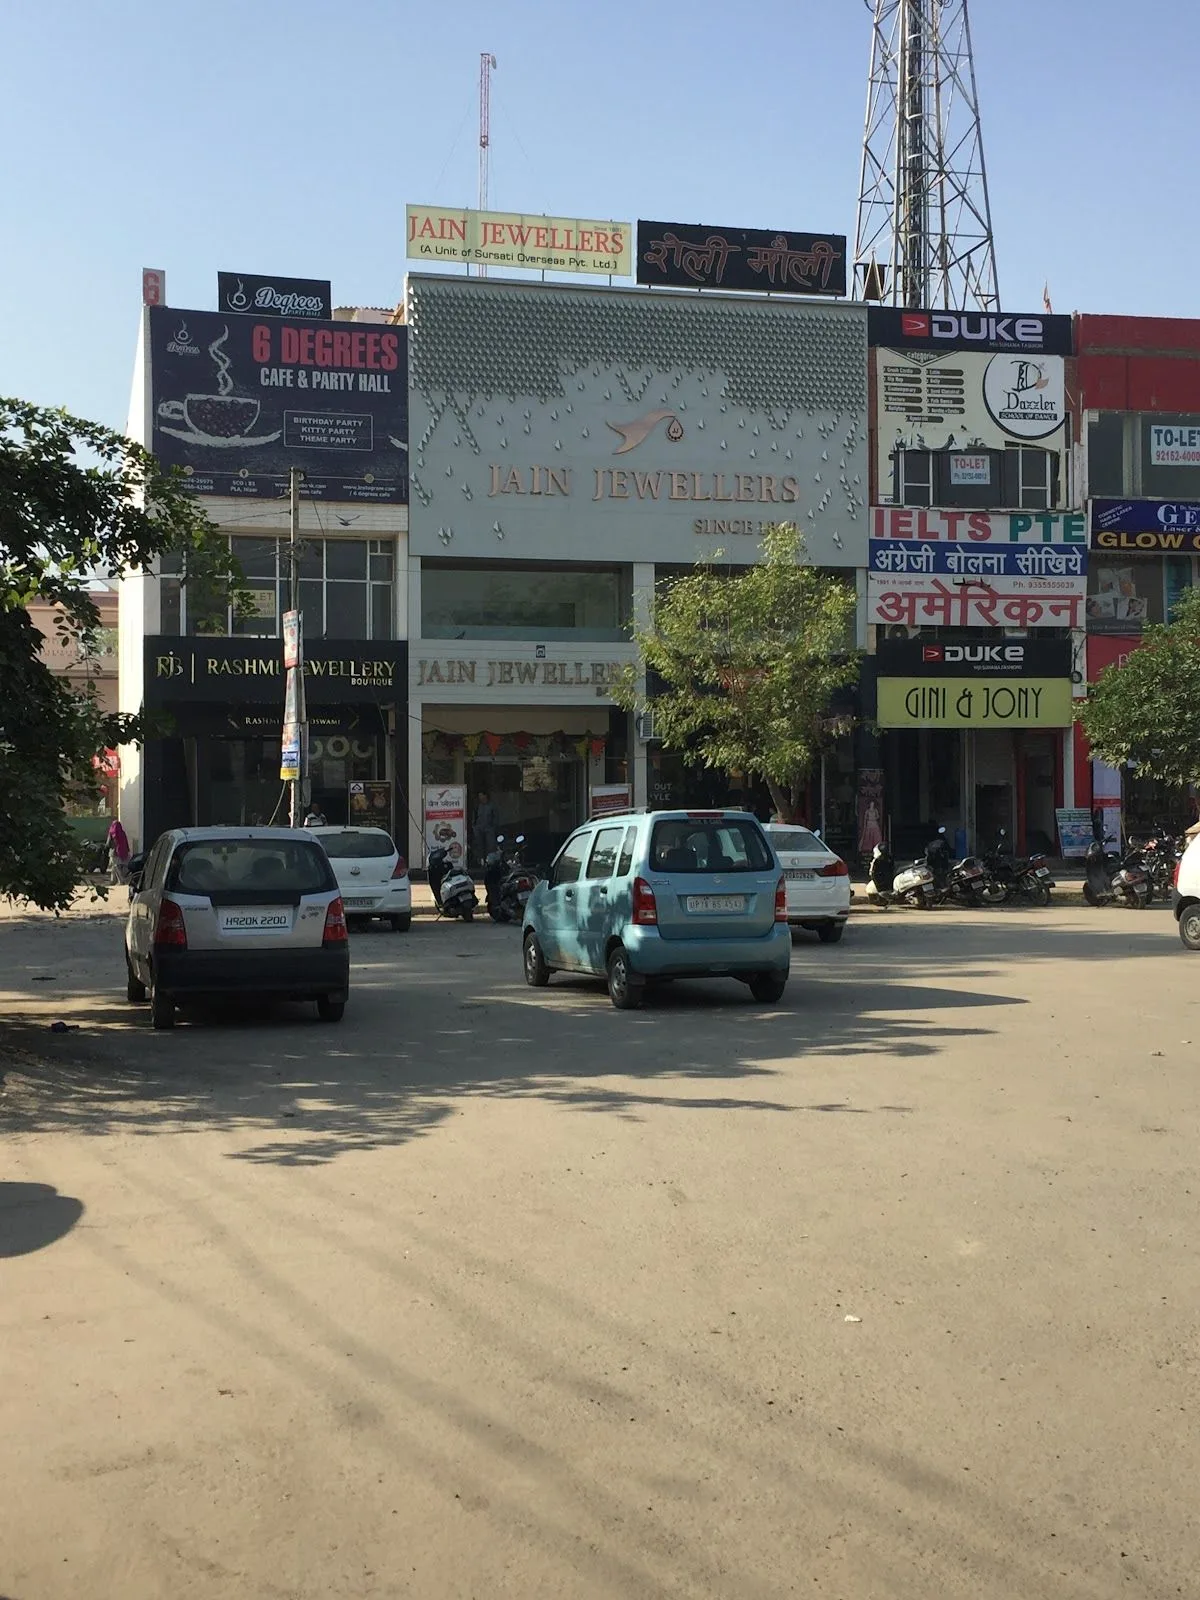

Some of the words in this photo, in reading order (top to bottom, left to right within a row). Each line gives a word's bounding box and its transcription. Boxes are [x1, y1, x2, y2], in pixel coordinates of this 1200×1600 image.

[408, 216, 468, 242] JAIN
[481, 222, 624, 254] JEWELLERS
[436, 246, 458, 256] Unit
[461, 248, 472, 257] of
[475, 249, 514, 261] Sursati
[517, 253, 565, 266] Overseas
[569, 258, 588, 268] Pvt.
[255, 286, 323, 316] Degrees
[253, 325, 271, 363] 6
[281, 327, 398, 371] DEGREES
[260, 367, 294, 388] CAFE
[298, 369, 308, 388] &
[312, 371, 354, 391] PARTY
[358, 373, 391, 393] HALL
[1002, 390, 1056, 411] Dazzler
[293, 417, 334, 426] BIRTHDAY
[336, 419, 363, 427] PARTY
[301, 426, 326, 434] KITTY
[300, 435, 328, 443] THEME
[330, 436, 357, 444] PARTY
[954, 457, 985, 469] TO-LET
[488, 464, 571, 498] JAIN
[592, 467, 801, 503] JEWELLERS
[694, 518, 753, 536] SINCE
[875, 509, 992, 542] IELTS
[1009, 514, 1085, 543] PTE
[1163, 525, 1192, 533] Laser
[1097, 531, 1184, 549] GLOW
[875, 543, 936, 573] अंग्रेजी
[945, 543, 1006, 574] बोलना
[1015, 546, 1083, 575] सीखिये
[875, 577, 1084, 628] अमेरिकन
[207, 658, 280, 676] RASHMI
[302, 660, 397, 678] EWELLERY
[417, 660, 477, 686] JAIN
[487, 661, 632, 687] JEWELLER
[351, 677, 393, 687] BOUTIQUE
[905, 687, 946, 719] GINI
[956, 687, 973, 719] &
[982, 687, 1042, 719] JONY
[260, 916, 287, 925] 2200
